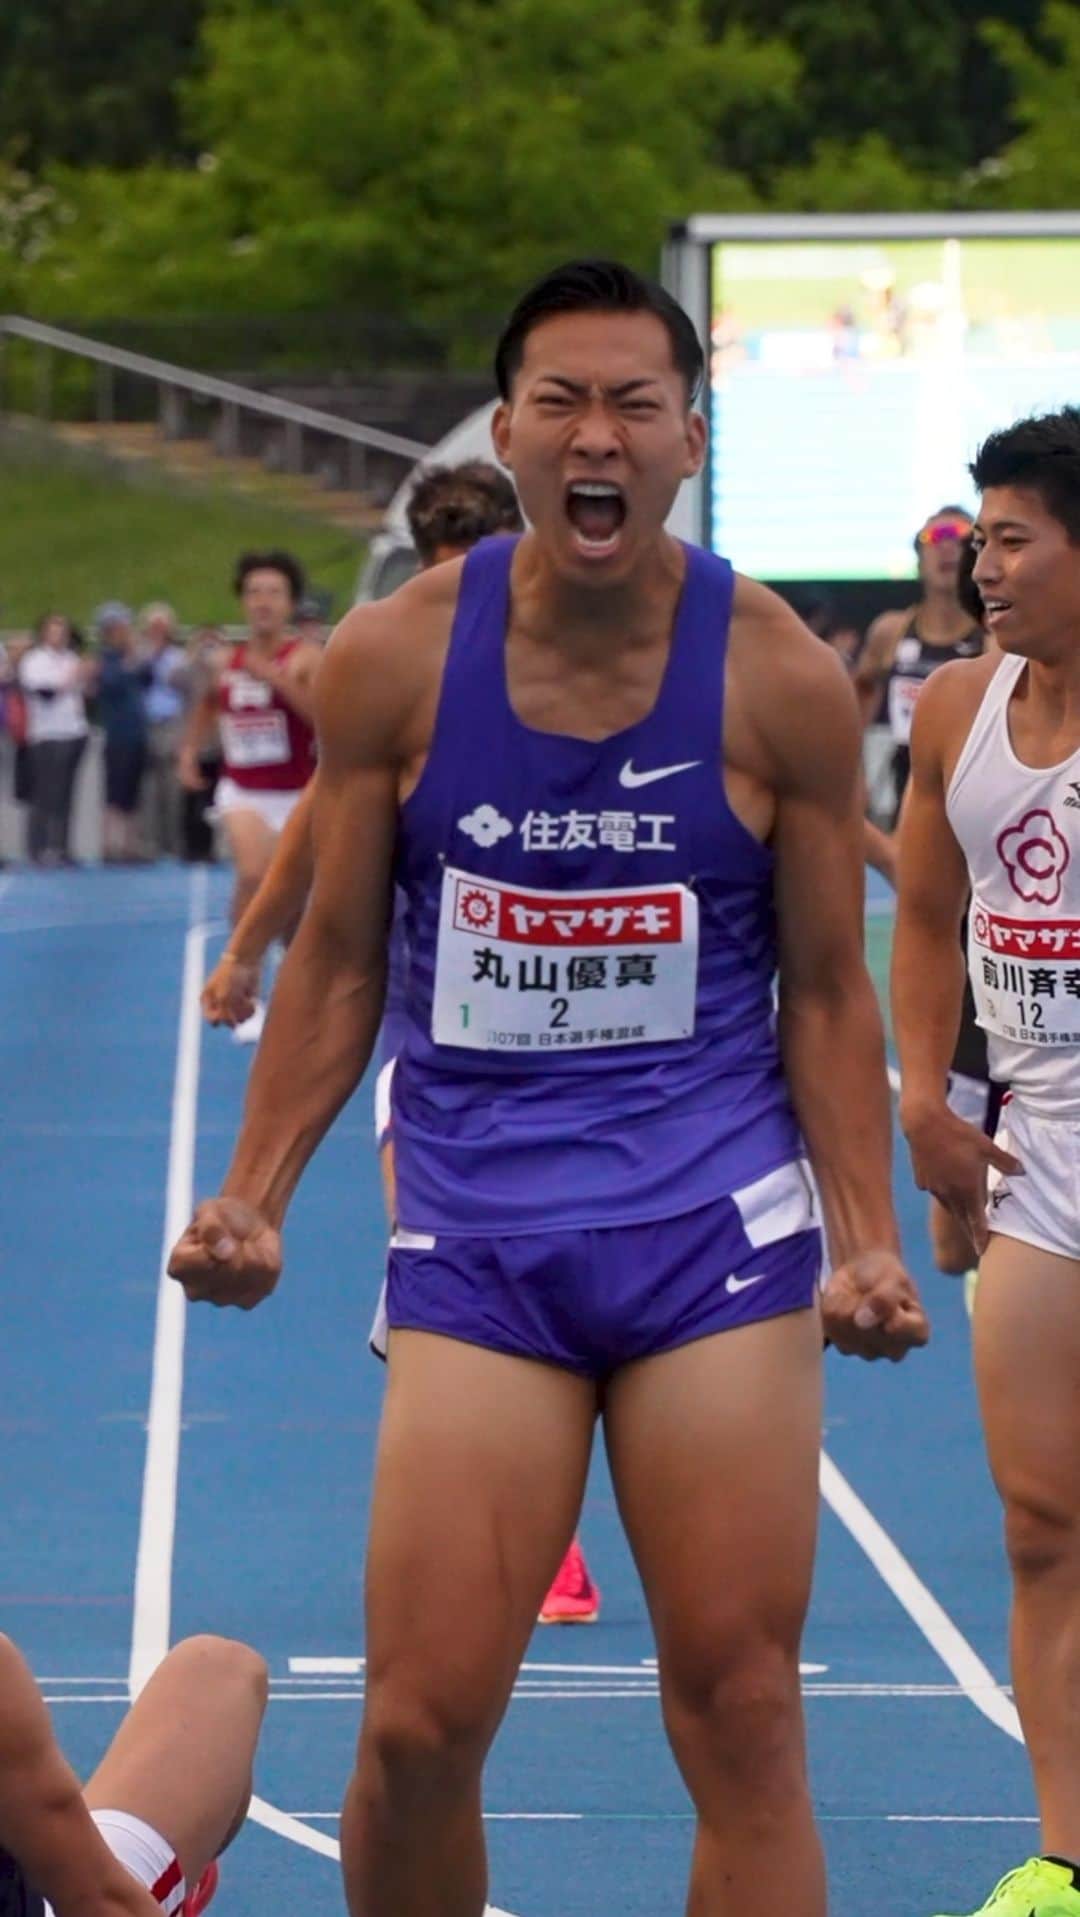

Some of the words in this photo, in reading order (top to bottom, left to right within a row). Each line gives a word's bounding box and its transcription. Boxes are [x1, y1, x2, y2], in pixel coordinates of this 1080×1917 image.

[519, 808, 677, 852] 住友電工
[508, 902, 671, 938] ヤマザキ
[471, 946, 658, 993] 丸山優真
[458, 1003, 471, 1029] 1
[549, 997, 570, 1029] 2
[1017, 1000, 1045, 1029] 12
